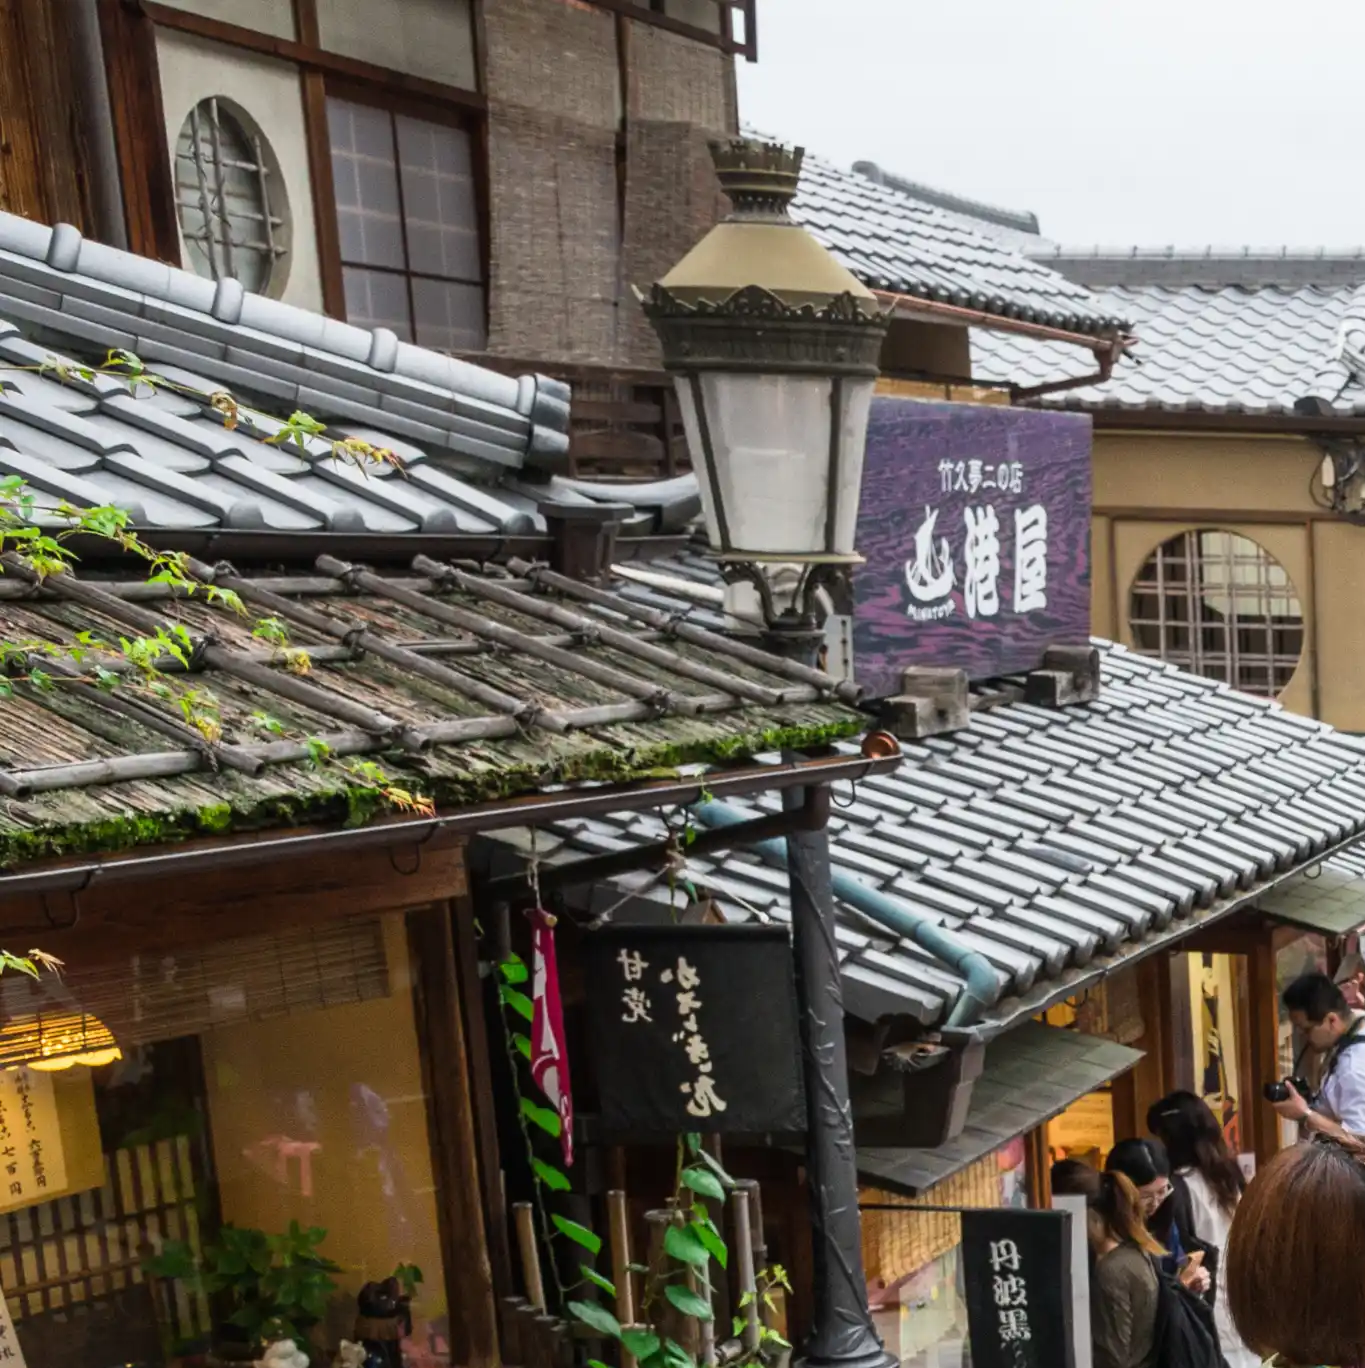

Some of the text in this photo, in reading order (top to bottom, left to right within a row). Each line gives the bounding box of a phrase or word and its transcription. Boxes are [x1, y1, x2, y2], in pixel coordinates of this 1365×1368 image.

[938, 457, 1024, 493] 竹久夢二の店
[963, 503, 1047, 619] 港屋
